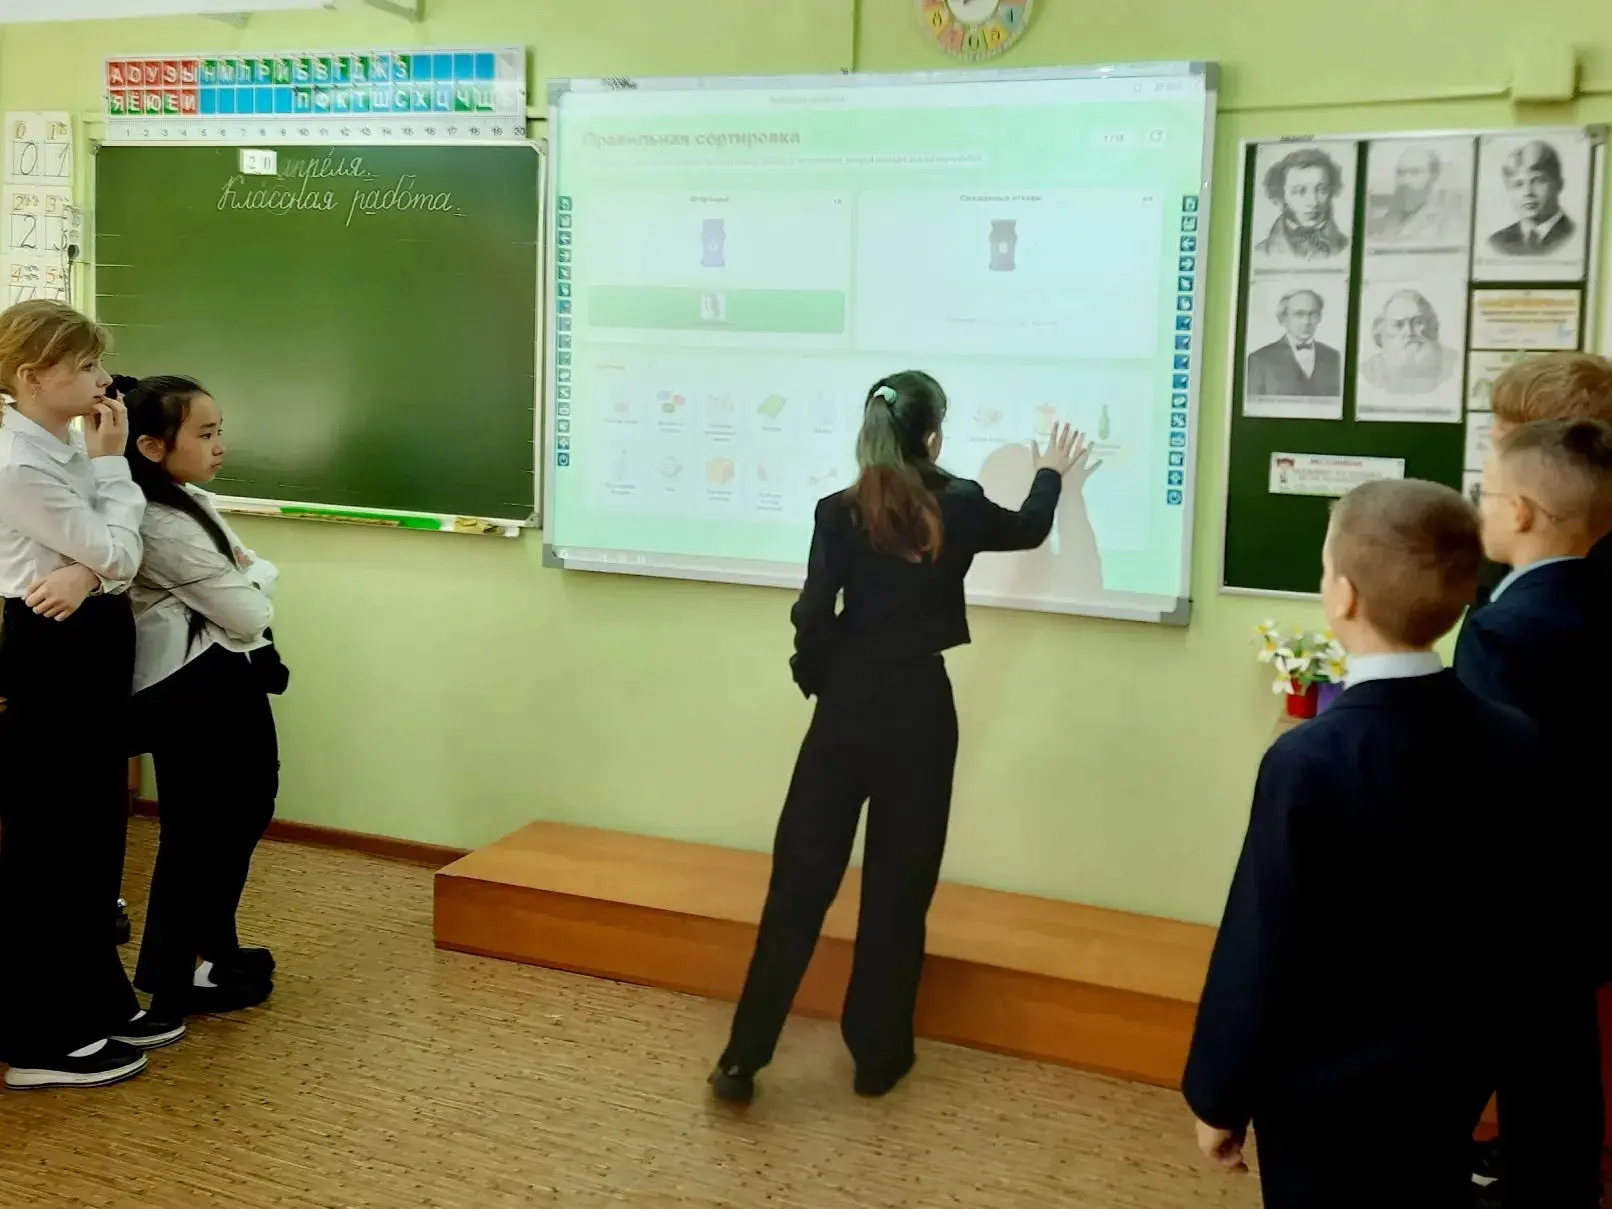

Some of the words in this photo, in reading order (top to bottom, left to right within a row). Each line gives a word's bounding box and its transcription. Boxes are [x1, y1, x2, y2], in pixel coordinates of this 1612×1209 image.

[111, 66, 123, 83] А
[129, 64, 142, 82] О
[146, 66, 158, 82] У
[164, 64, 177, 82] Э
[182, 65, 197, 82] Ы
[258, 64, 270, 81] Р
[112, 95, 124, 111] Я
[147, 94, 161, 111] Ю
[296, 92, 308, 109] П
[353, 91, 366, 108] Т
[371, 91, 389, 108] Ш
[395, 89, 410, 108] С
[414, 90, 428, 109] Х
[456, 90, 470, 109] Ч
[16, 122, 27, 139] 0
[51, 123, 58, 140] 1
[126, 129, 130, 137] 1
[143, 129, 149, 137] 2
[162, 129, 168, 137] 3
[181, 129, 187, 137] 4
[201, 129, 207, 137] 5
[220, 129, 226, 137] 6
[240, 129, 246, 137] 7
[259, 129, 266, 137] 8
[280, 129, 287, 137] 9
[299, 129, 309, 137] 10
[695, 130, 800, 149] сортировка
[20, 141, 38, 175] 0
[13, 195, 25, 211] 2
[46, 196, 57, 212] 3
[217, 175, 338, 212] Классная
[346, 174, 463, 227] работа.
[20, 215, 37, 249] 2
[11, 266, 22, 282] 4
